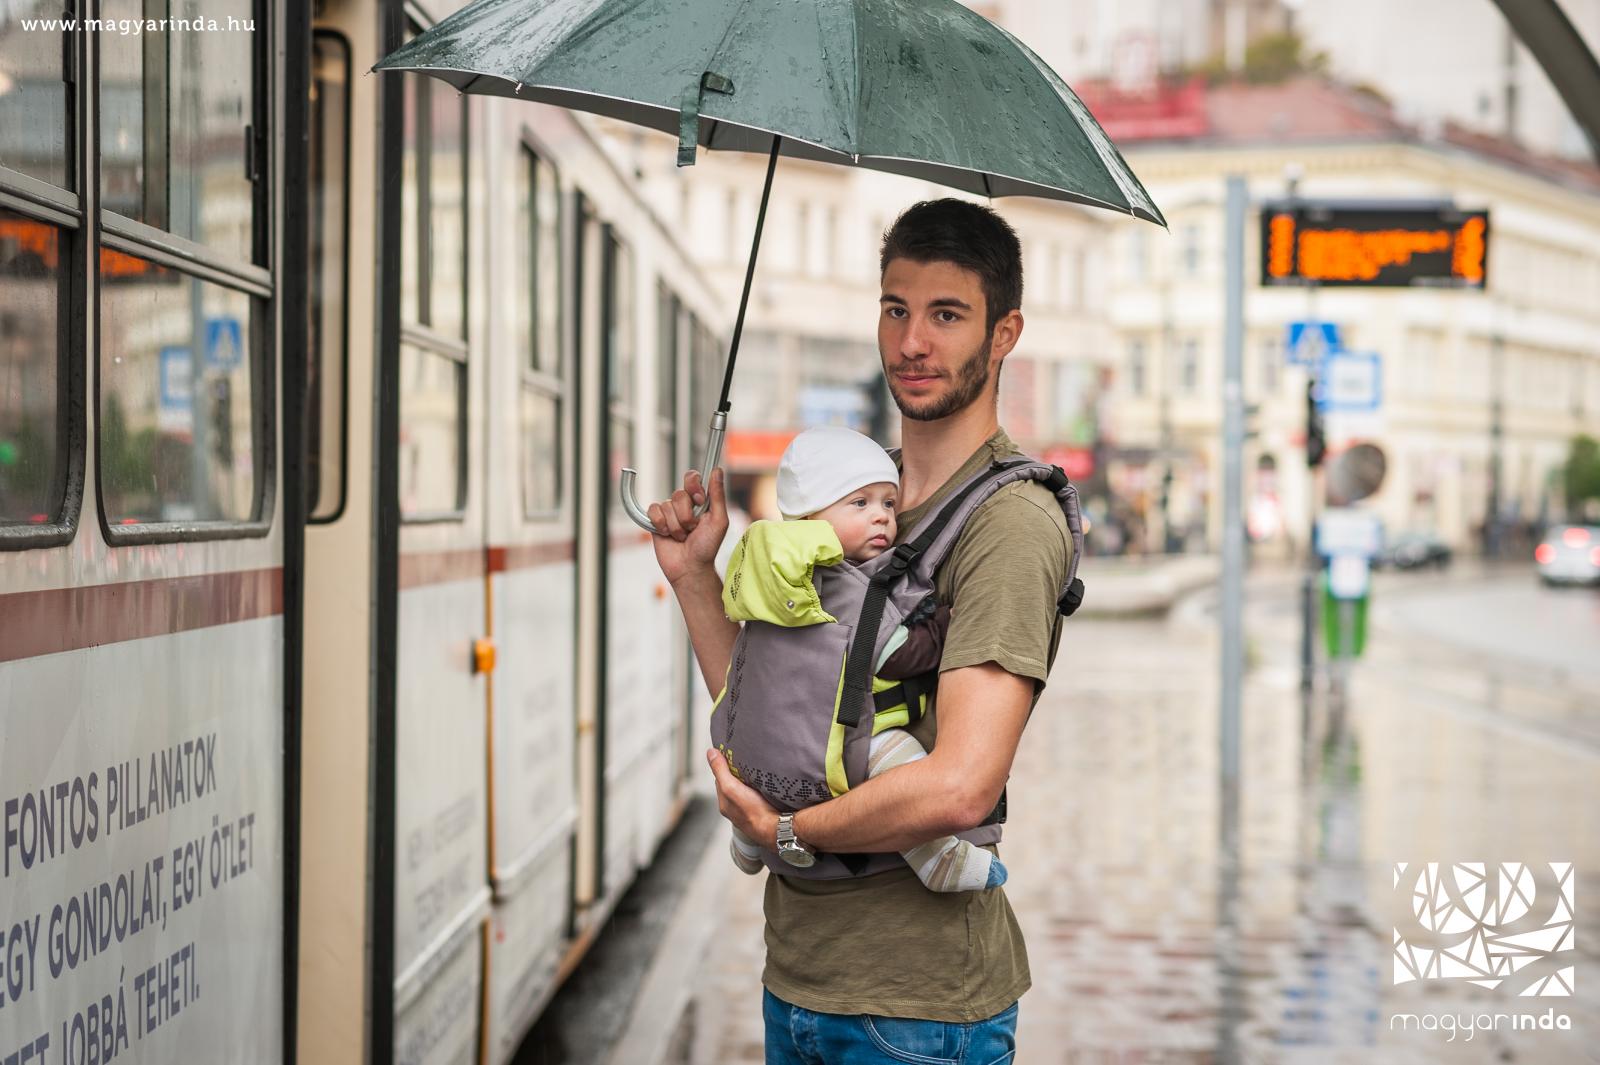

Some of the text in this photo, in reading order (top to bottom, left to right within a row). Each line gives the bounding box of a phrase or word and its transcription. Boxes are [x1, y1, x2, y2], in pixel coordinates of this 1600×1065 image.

[4, 733, 217, 877] FONTOS PILLANATOK
[48, 856, 167, 979] GONDOLAT,
[172, 836, 205, 912] EGY
[210, 812, 255, 890] ÖTLET
[134, 942, 200, 1040] TEHETI.
